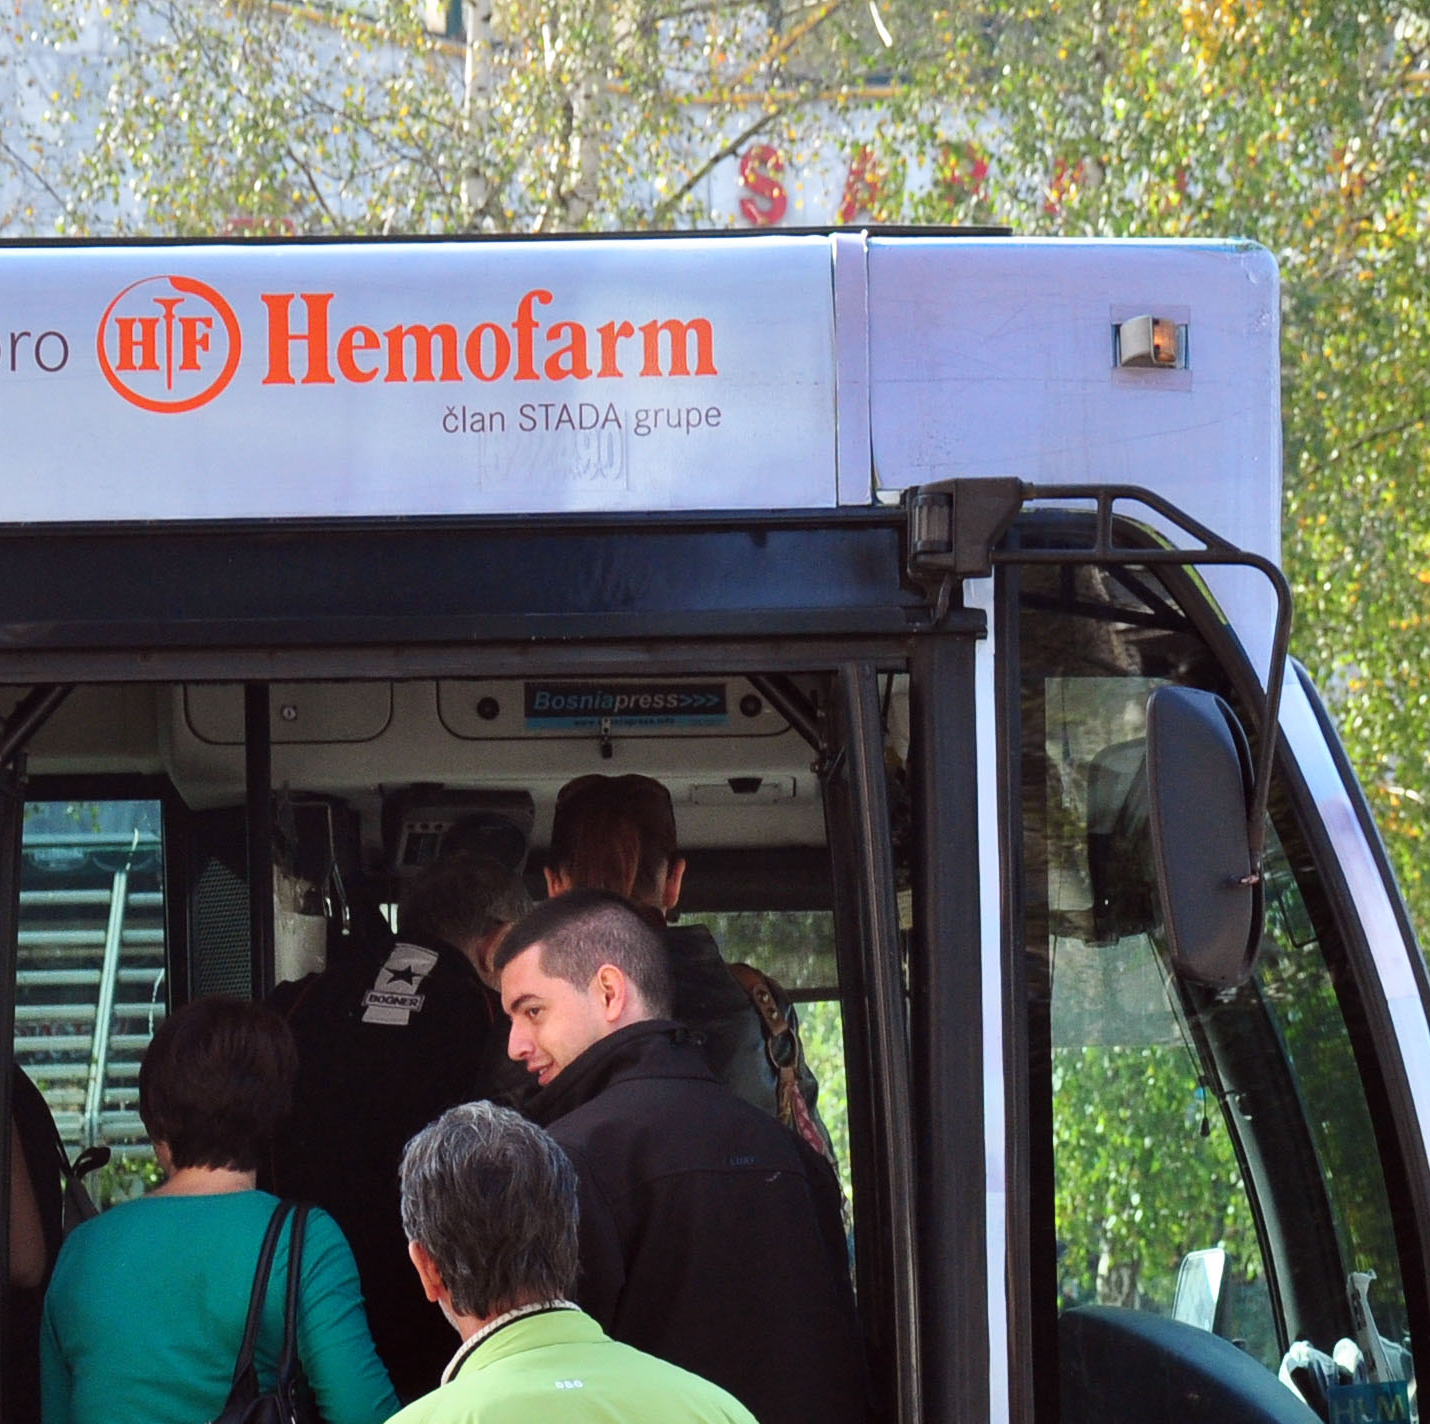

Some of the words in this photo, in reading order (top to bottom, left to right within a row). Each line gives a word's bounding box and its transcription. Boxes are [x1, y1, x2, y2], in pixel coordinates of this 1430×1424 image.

[262, 290, 717, 385] Hemofarm
[442, 403, 506, 434] član
[518, 402, 622, 433] STADA
[633, 405, 722, 437] grupe
